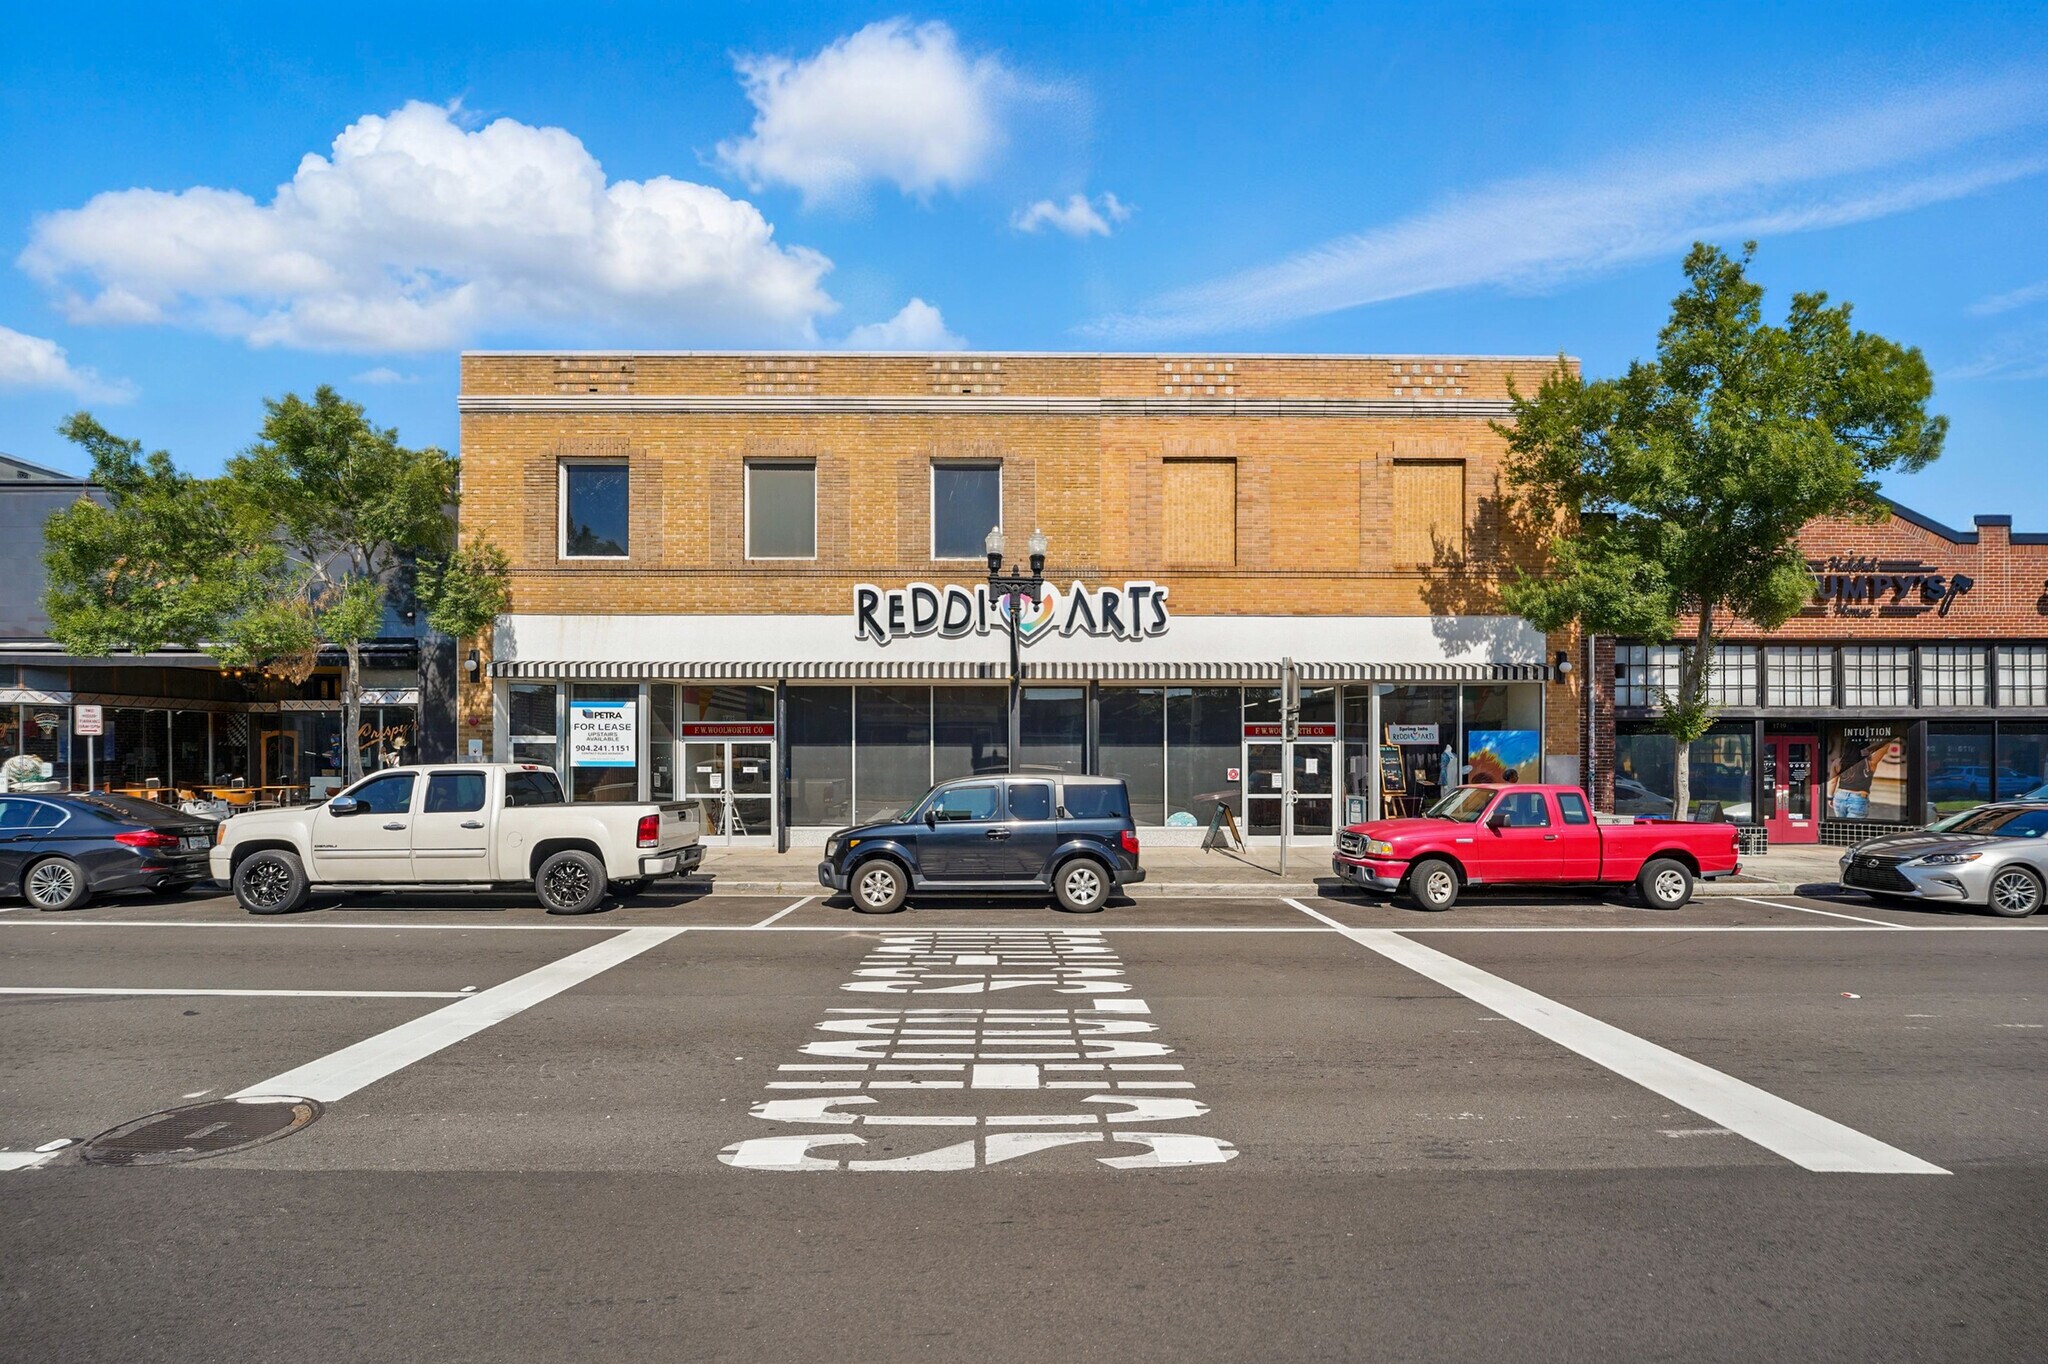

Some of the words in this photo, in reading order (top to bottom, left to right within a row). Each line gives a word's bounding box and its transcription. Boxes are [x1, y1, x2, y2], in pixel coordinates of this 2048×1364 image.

[858, 587, 986, 637] REDDI
[1065, 587, 1166, 637] ARTS
[594, 711, 622, 719] PETRA
[574, 723, 595, 731] FOR
[598, 723, 632, 731] LEASE
[753, 726, 765, 734] CO.
[1313, 727, 1325, 735] CO.
[1420, 732, 1435, 740] ARTS
[1844, 726, 1891, 738] INTUITION
[575, 744, 630, 752] 904.241.1151
